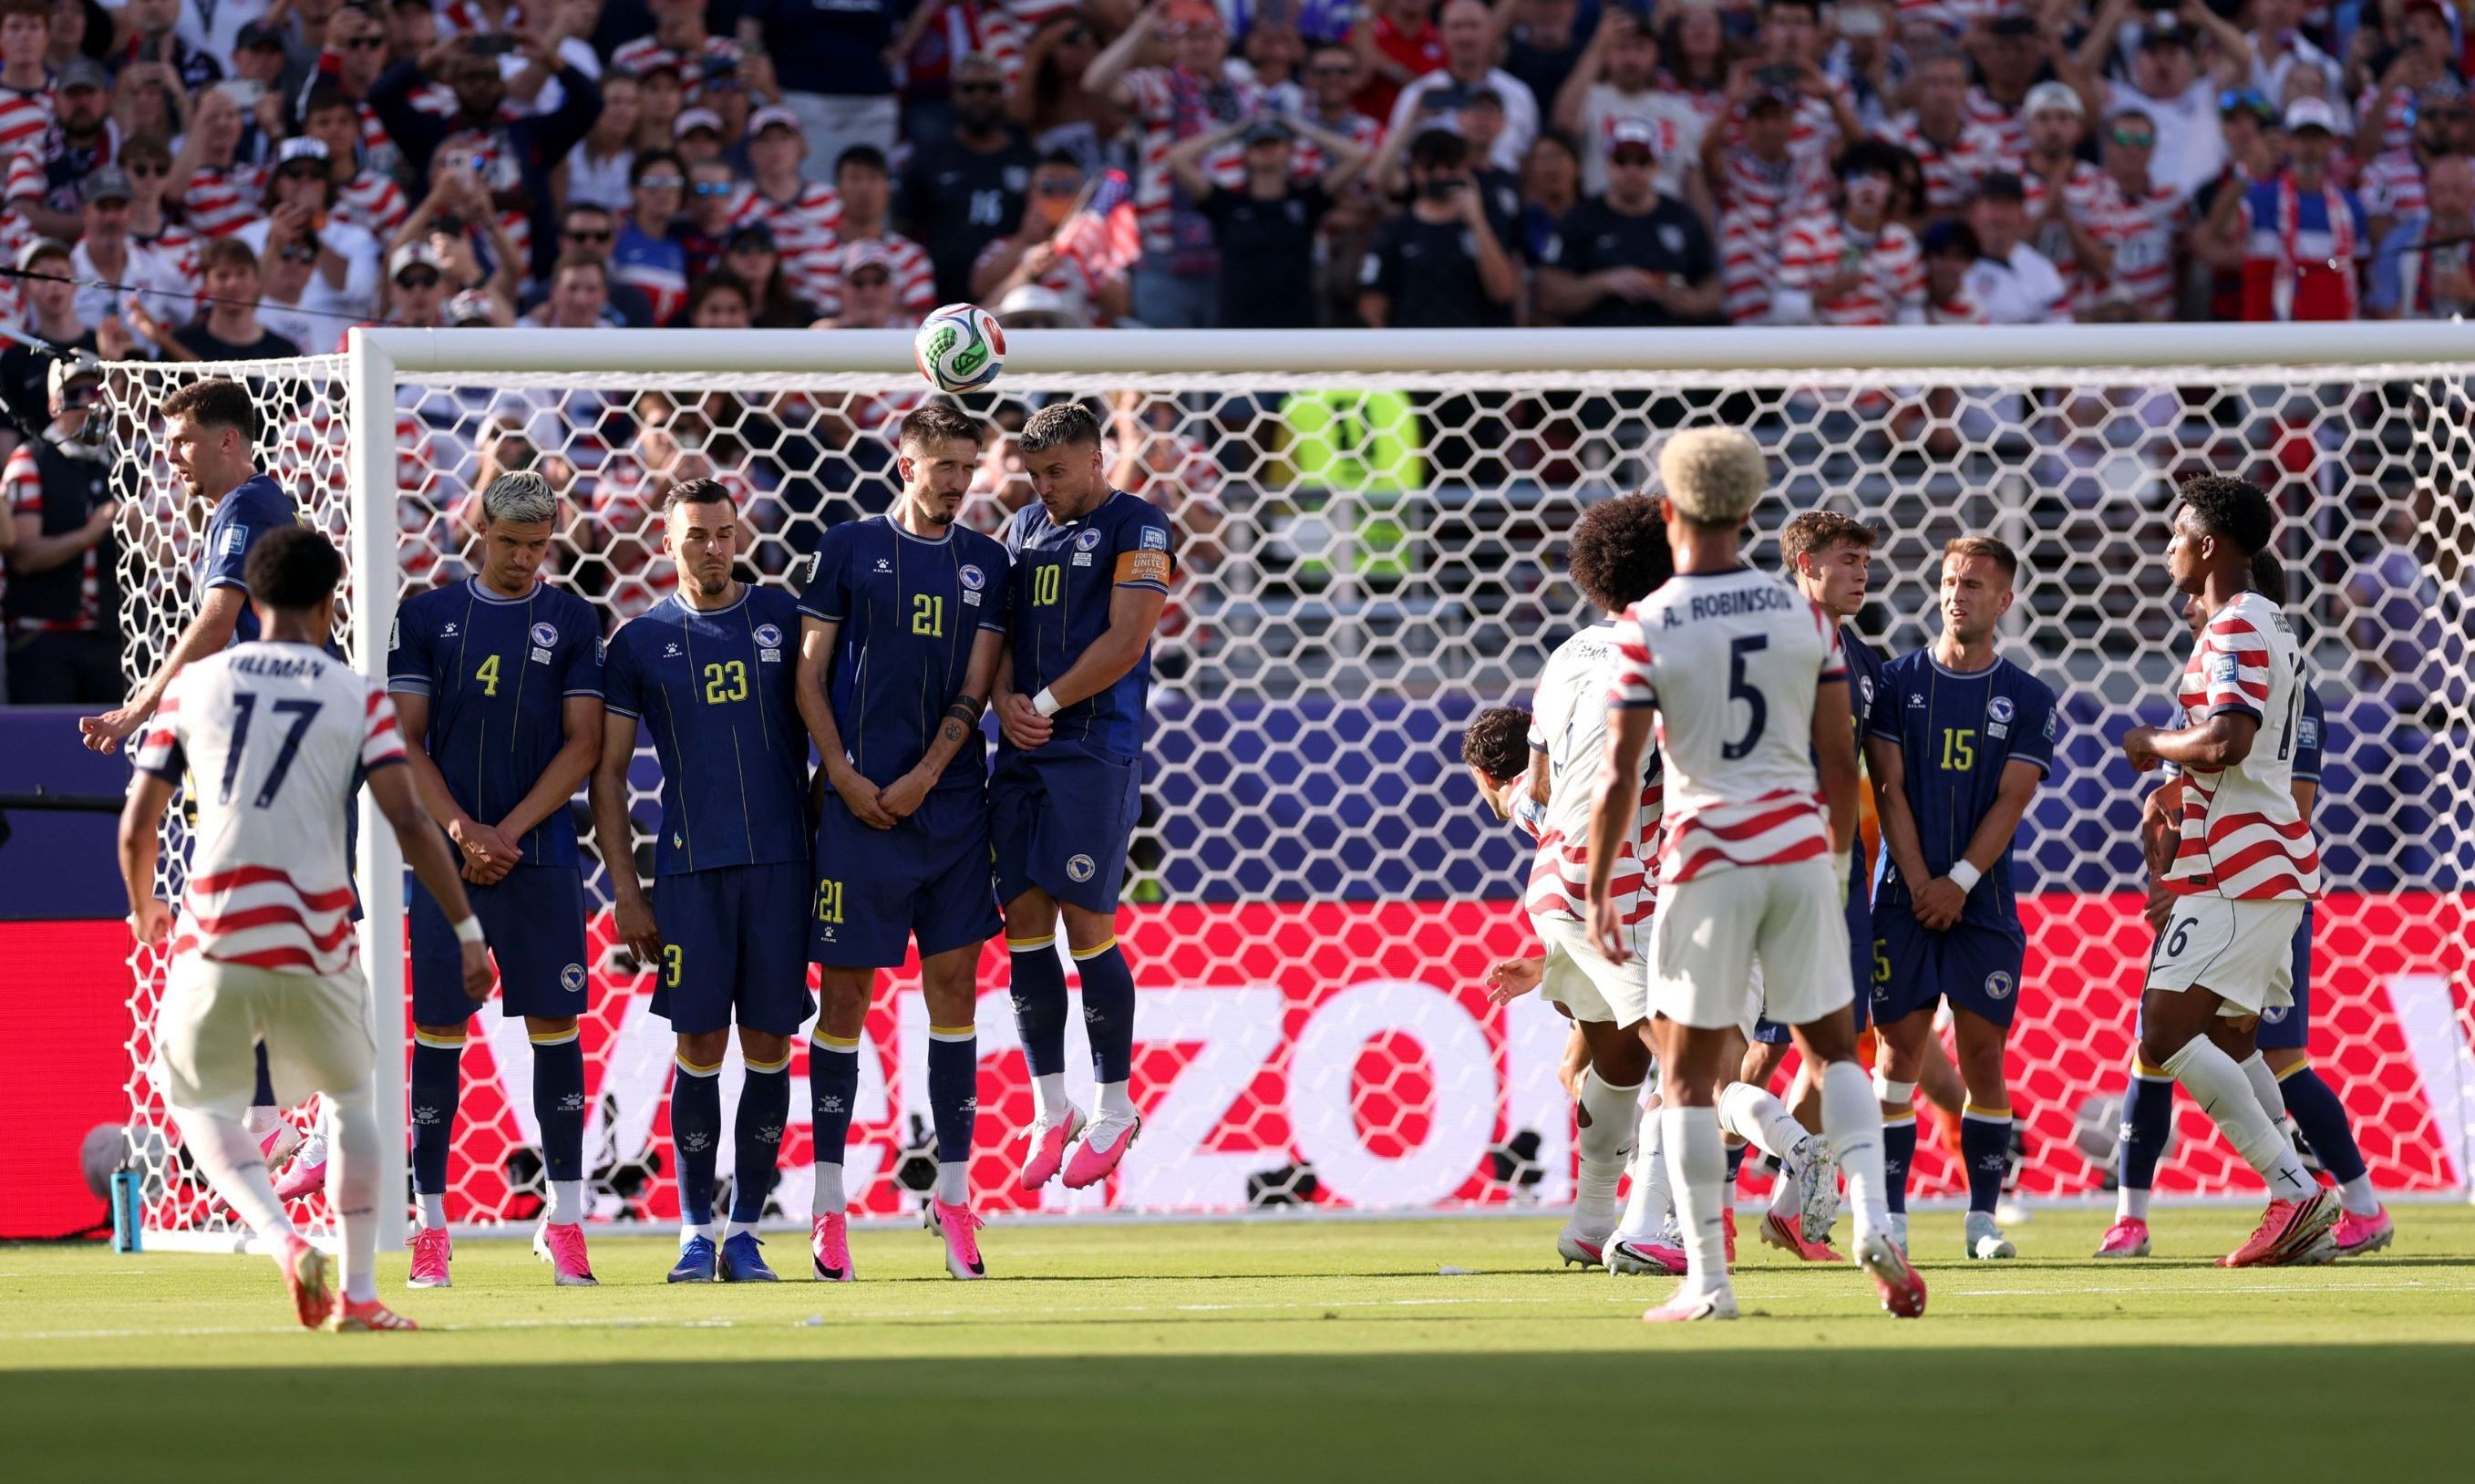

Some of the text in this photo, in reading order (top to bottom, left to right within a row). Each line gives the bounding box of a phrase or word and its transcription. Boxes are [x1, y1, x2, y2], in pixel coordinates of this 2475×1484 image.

[1133, 559, 1166, 569] UNITES
[1135, 552, 1166, 562] FOOTBALL
[1033, 564, 1060, 607] 10
[912, 593, 943, 638] 21
[1664, 587, 1792, 631] A. ROBINSON
[476, 654, 500, 697] 4
[704, 660, 748, 705] 23
[1721, 634, 1769, 760] 5
[219, 692, 324, 809] 17
[1941, 727, 1975, 771] 15
[820, 879, 844, 924] 21
[1871, 938, 1891, 982] 5
[684, 1142, 711, 1152] KELME
[755, 1135, 781, 1144] KELM
